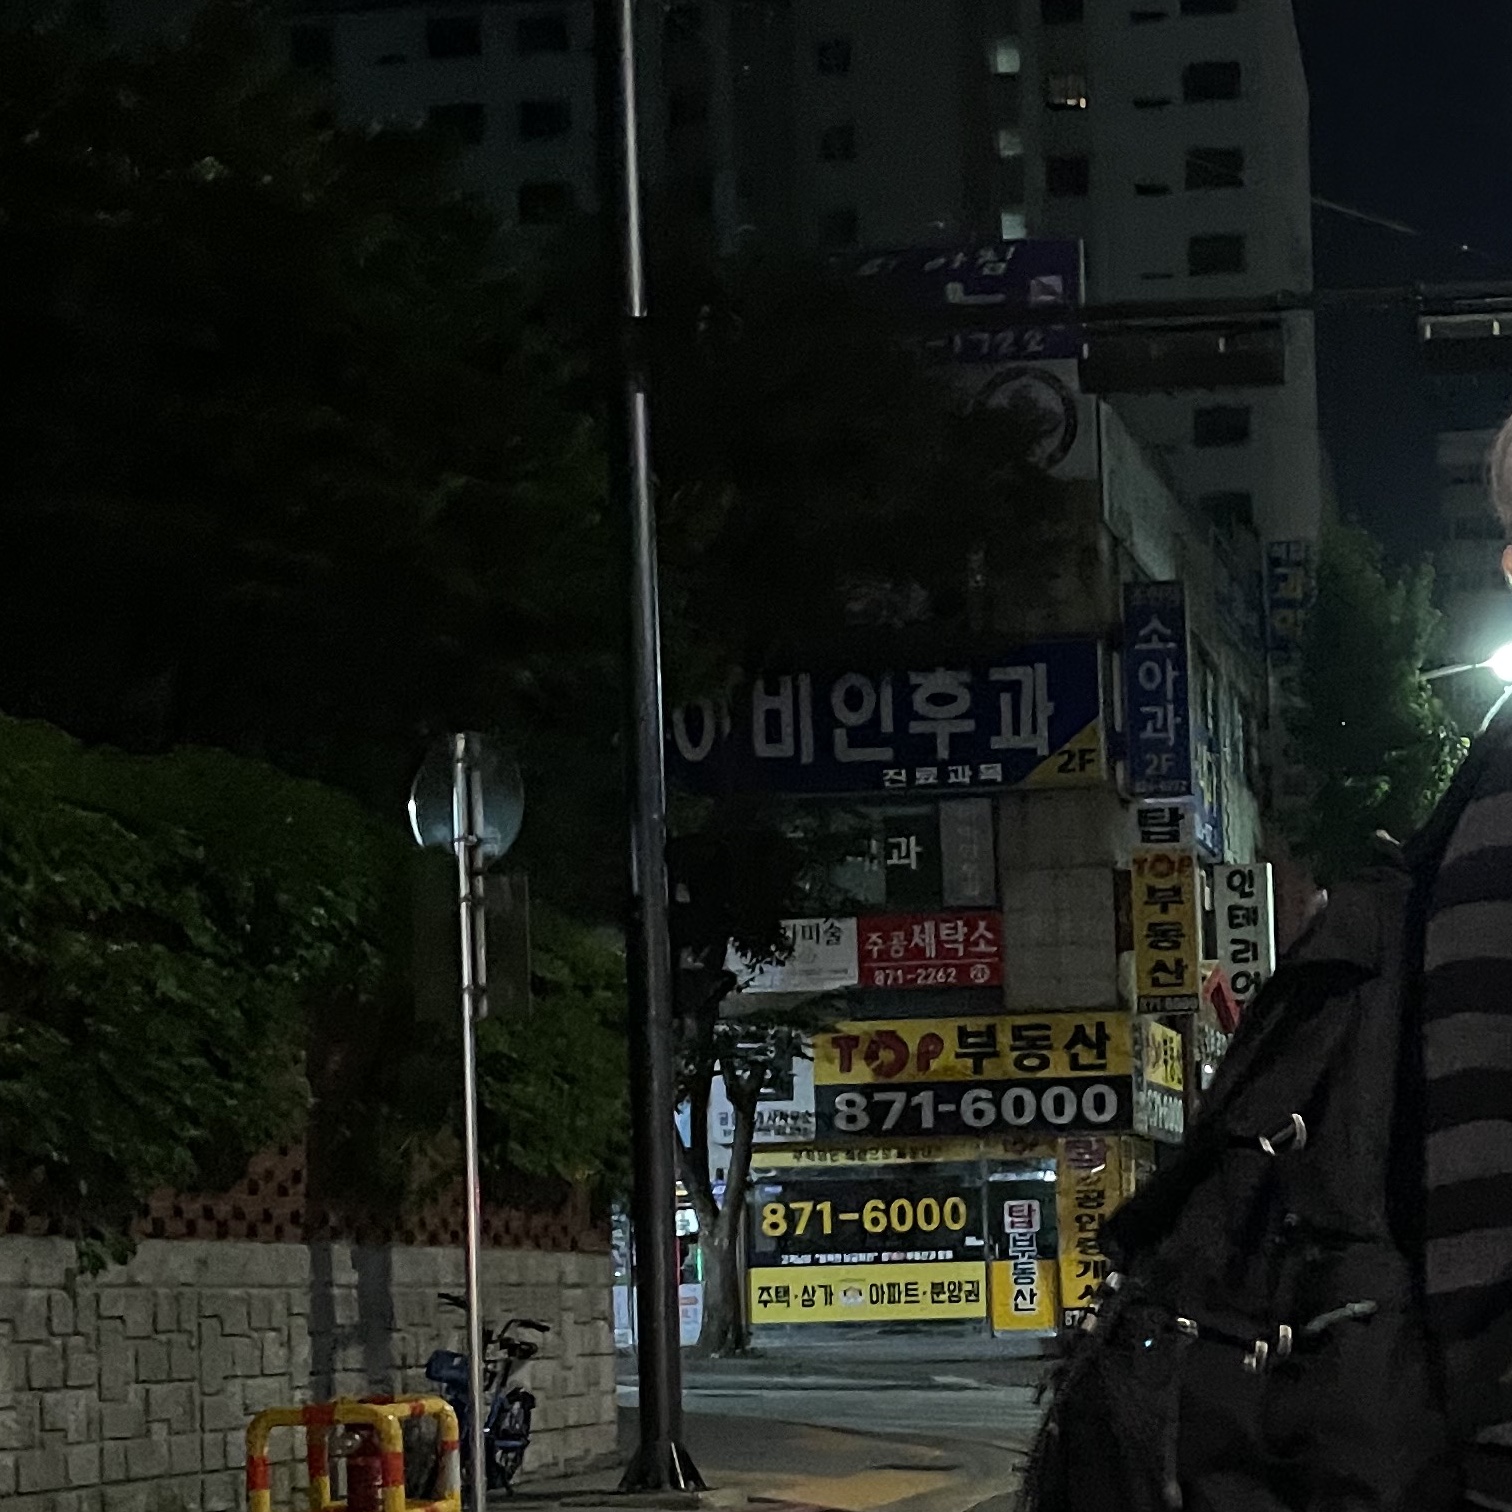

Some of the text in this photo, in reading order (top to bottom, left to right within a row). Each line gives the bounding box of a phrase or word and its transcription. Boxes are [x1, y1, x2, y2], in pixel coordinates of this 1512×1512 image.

[1134, 613, 1182, 747] 소아과
[881, 762, 1003, 788] 진료과목
[1056, 747, 1097, 775] 2F
[1142, 884, 1189, 988] 부동산
[831, 1029, 945, 1079] TOP
[954, 1021, 1111, 1077] 부동산
[833, 1083, 1119, 1133] 871-6000
[761, 1196, 968, 1237] 871-6000
